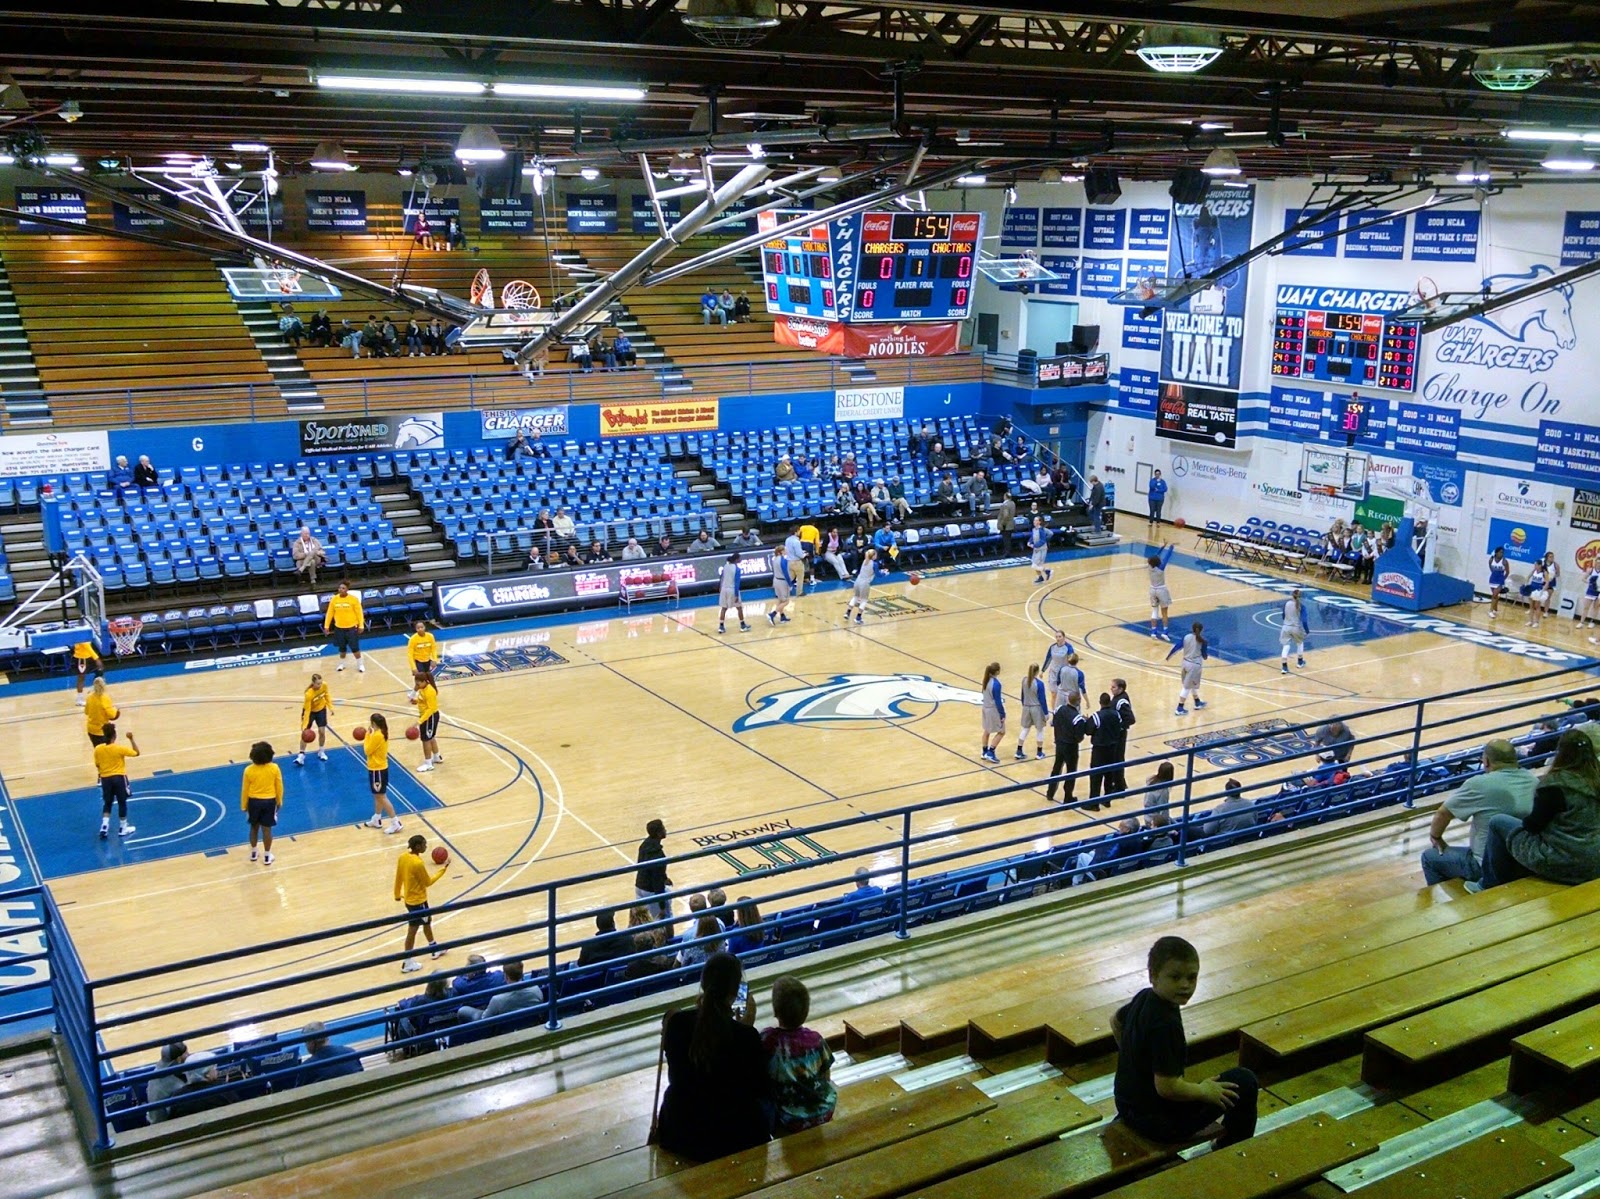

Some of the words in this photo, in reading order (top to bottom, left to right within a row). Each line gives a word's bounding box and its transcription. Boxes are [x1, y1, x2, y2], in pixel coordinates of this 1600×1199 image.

[17, 205, 40, 214] MEN'S
[42, 206, 87, 214] BASKETBALL
[914, 216, 950, 238] 1:54
[1447, 218, 1466, 227] NCAA
[1360, 231, 1390, 240] SOFTBALL
[1415, 232, 1437, 241] WOMEN'S
[1438, 233, 1456, 242] TRACK
[1462, 233, 1477, 242] FIELD
[1563, 235, 1584, 245] MEN'S
[865, 242, 904, 254] CHARGERS
[907, 248, 930, 256] PERIOD
[932, 242, 972, 254] CHOCTAWS
[1413, 246, 1441, 254] REGIONAL
[1442, 247, 1475, 255] CHAMPIONS
[1562, 250, 1592, 259] NATIONAL
[836, 214, 853, 318] CHARGERS
[880, 257, 893, 279] 0
[917, 260, 923, 275] 1
[958, 256, 971, 278] 0
[857, 282, 877, 290] FOULS
[894, 281, 917, 289] PLAYER
[919, 281, 934, 289] FOUL
[951, 280, 970, 288] FOULS
[863, 290, 874, 307] 0
[956, 288, 967, 305] 0
[1277, 286, 1318, 306] UAH
[853, 310, 874, 319] SCORE
[947, 309, 966, 317] SCORE
[1165, 311, 1225, 336] WELCOME
[1227, 316, 1244, 339] TO
[1338, 314, 1361, 330] 1:54
[1308, 329, 1334, 339] CHARGERS
[1351, 333, 1378, 342] CHOCTAWS
[1442, 325, 1482, 344] UAH
[868, 341, 925, 356] NOODLES
[1274, 341, 1284, 349] 21
[1317, 339, 1326, 354] 0
[1368, 344, 1377, 360] 0
[1170, 332, 1233, 386] UAH
[1273, 353, 1283, 361] 24
[1436, 341, 1559, 374] CHARGERS
[1307, 360, 1314, 372] 0
[1367, 366, 1375, 378] 0
[1380, 376, 1390, 385] 21
[836, 390, 902, 408] REDSTONE
[943, 393, 951, 405] J
[1295, 395, 1311, 404] NCAA
[1422, 372, 1511, 419] Charge
[1520, 381, 1563, 416] On
[836, 409, 862, 418] FEDERAL
[862, 408, 884, 416] CREDIT
[884, 406, 902, 415] UNION
[1187, 408, 1209, 420] REAL
[1209, 411, 1236, 423] TASTE
[1270, 406, 1284, 414] MEN'S
[1299, 410, 1321, 420] COUNTRY
[1347, 403, 1364, 414] 1:54
[485, 414, 565, 430] CHARGER
[1164, 412, 1181, 421] zero
[1342, 413, 1359, 430] 30
[1403, 410, 1418, 419] 2010
[1427, 413, 1434, 421] 11
[1436, 414, 1454, 424] NCAA
[1269, 418, 1292, 426] REGIONAL
[1292, 421, 1320, 431] CHAMPIONS
[1397, 424, 1417, 433] MEN'S
[1418, 426, 1457, 439] BASKETBALL
[304, 421, 389, 445] SportsMED
[1545, 428, 1562, 438] 2010
[1574, 432, 1581, 441] 11
[192, 437, 204, 451] G
[1396, 436, 1422, 446] REGIONAL
[1424, 440, 1456, 451] CHAMPIONS
[1538, 443, 1560, 453] MEN'S
[1536, 457, 1564, 468] NATIONAL
[1191, 460, 1247, 480] Mercedes-Benz
[1261, 482, 1302, 499] SportsMED
[1498, 491, 1547, 509] CRESTWOOD
[1367, 510, 1402, 524] REGIONS
[1503, 542, 1531, 555] Comfort
[493, 587, 550, 603] CHARGERS
[1206, 568, 1320, 591] UAH
[1312, 595, 1587, 661] CHARGERS
[184, 644, 329, 669] BENTLEY
[216, 652, 322, 669] bentleyauto.com
[1207, 736, 1316, 768] COUR
[691, 818, 795, 847] BROADWAY
